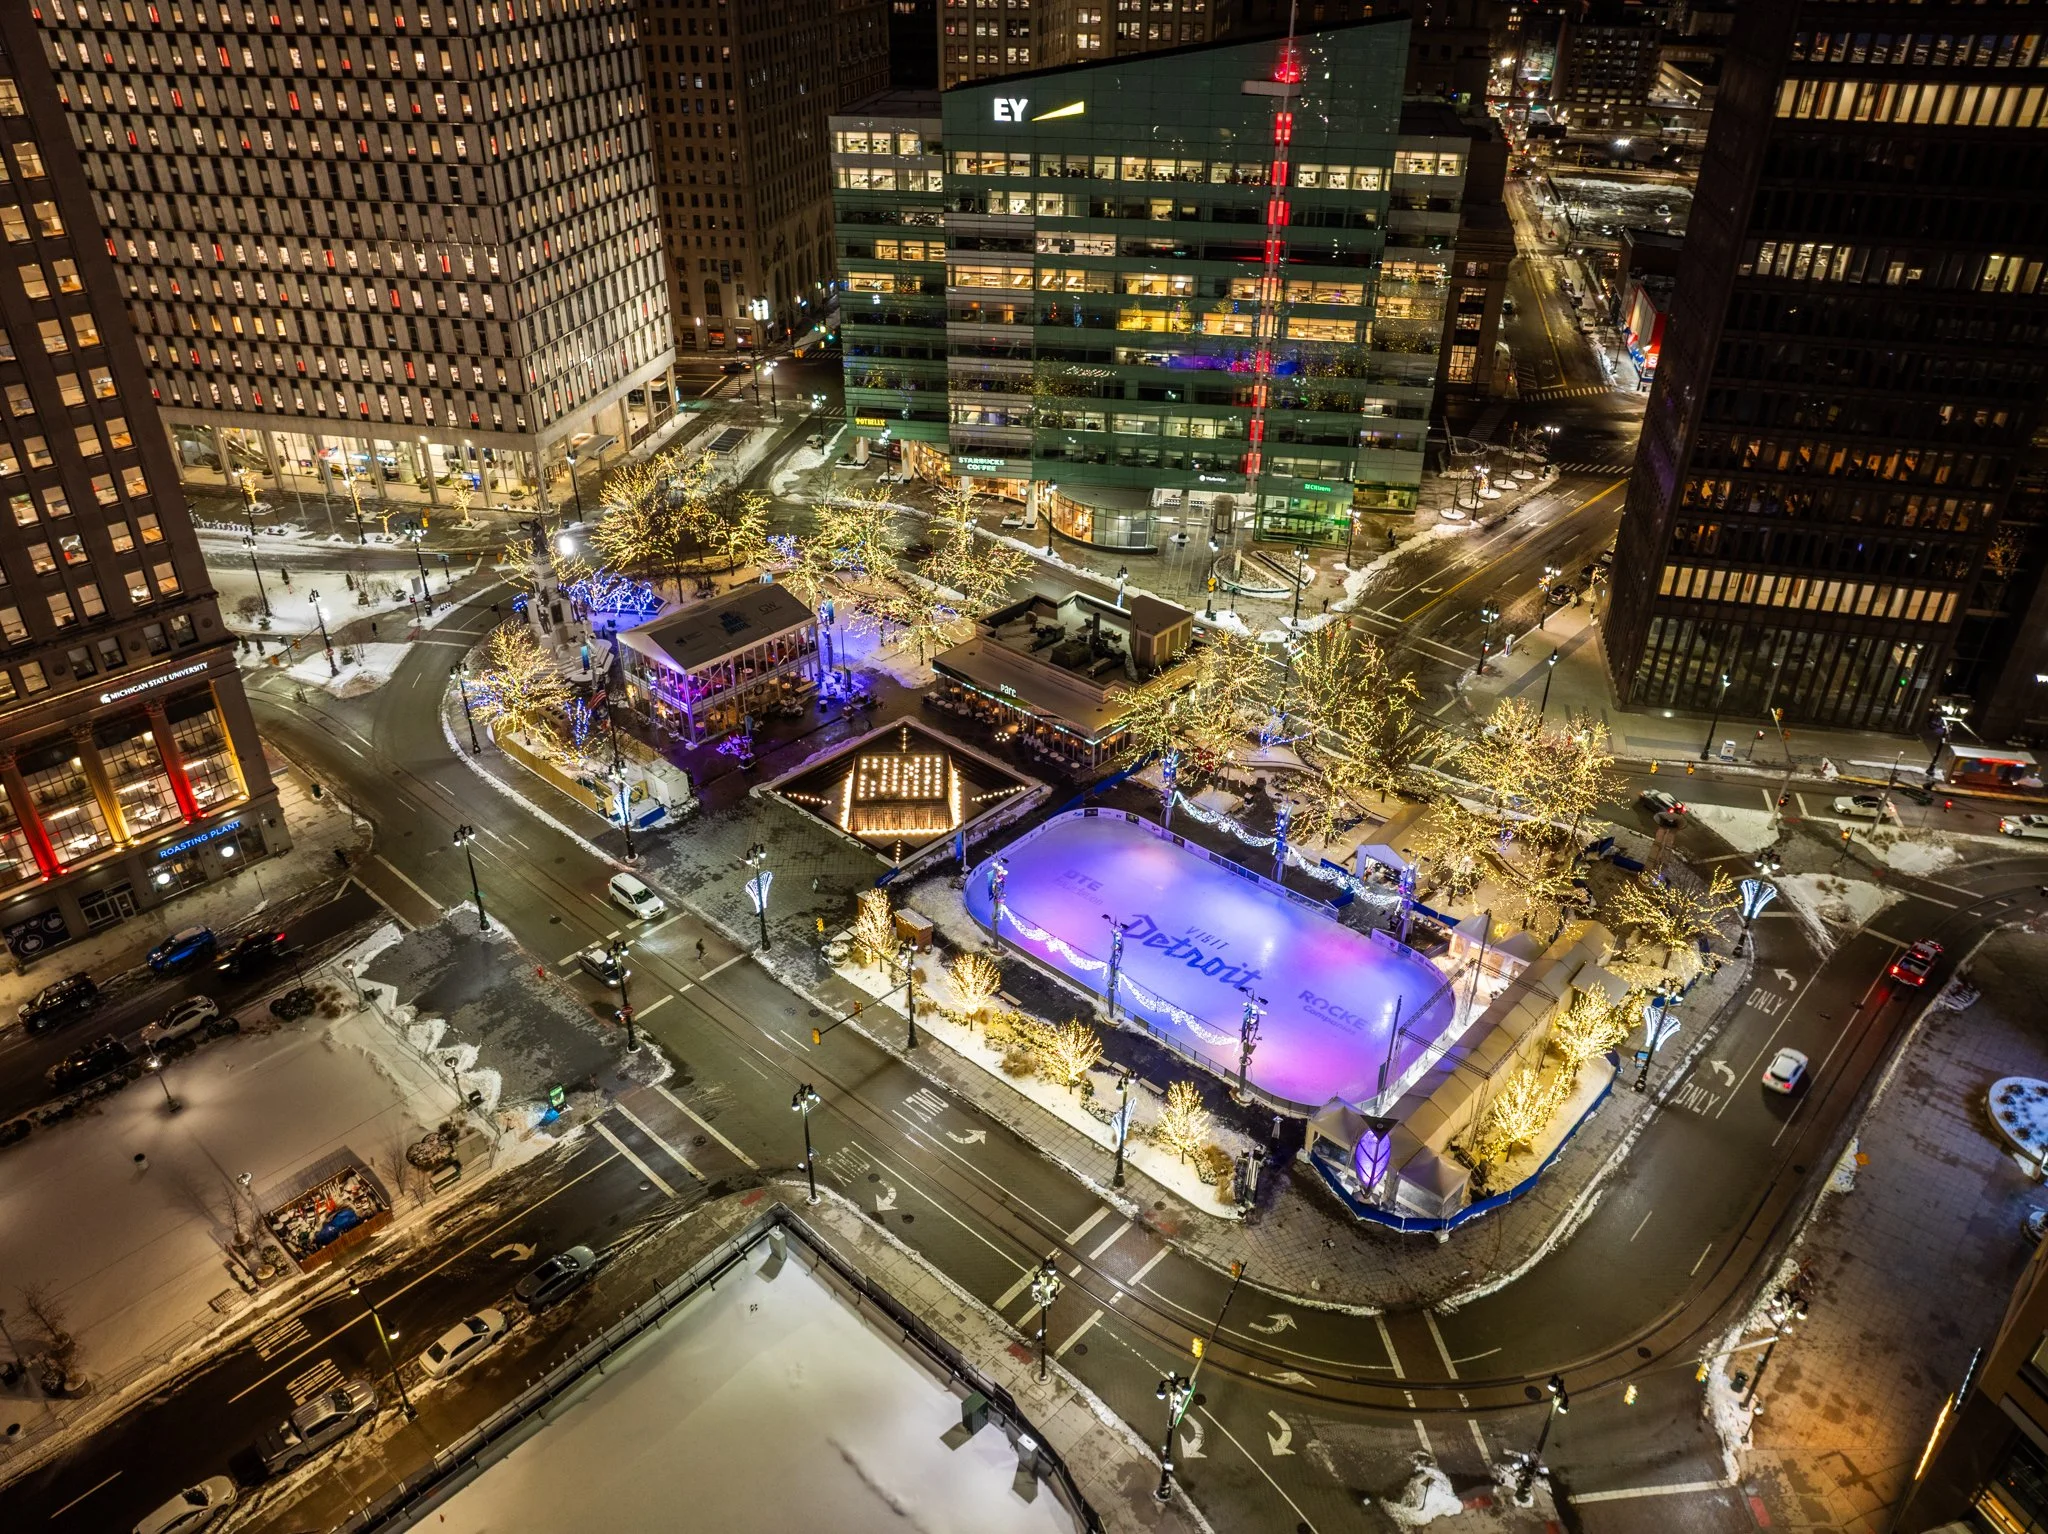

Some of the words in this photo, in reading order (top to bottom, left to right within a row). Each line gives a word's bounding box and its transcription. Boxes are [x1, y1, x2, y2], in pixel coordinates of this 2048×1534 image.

[994, 97, 1028, 122] EY
[855, 417, 886, 427] POTBELLY
[958, 456, 1005, 466] STARBUCKS
[967, 464, 996, 472] COFFEE
[110, 682, 149, 700] MICHIGAN
[148, 675, 169, 688] STATE
[168, 661, 208, 682] UNIVERSITY
[160, 833, 208, 859] ROASTING
[209, 820, 240, 839] PLANT
[1062, 869, 1105, 892] DTE
[1185, 926, 1230, 950] VISIT
[1121, 914, 1263, 991] Detroit
[1746, 987, 1788, 1016] ONLY
[902, 1087, 949, 1124] ONLY
[1678, 1082, 1721, 1116] ONLY
